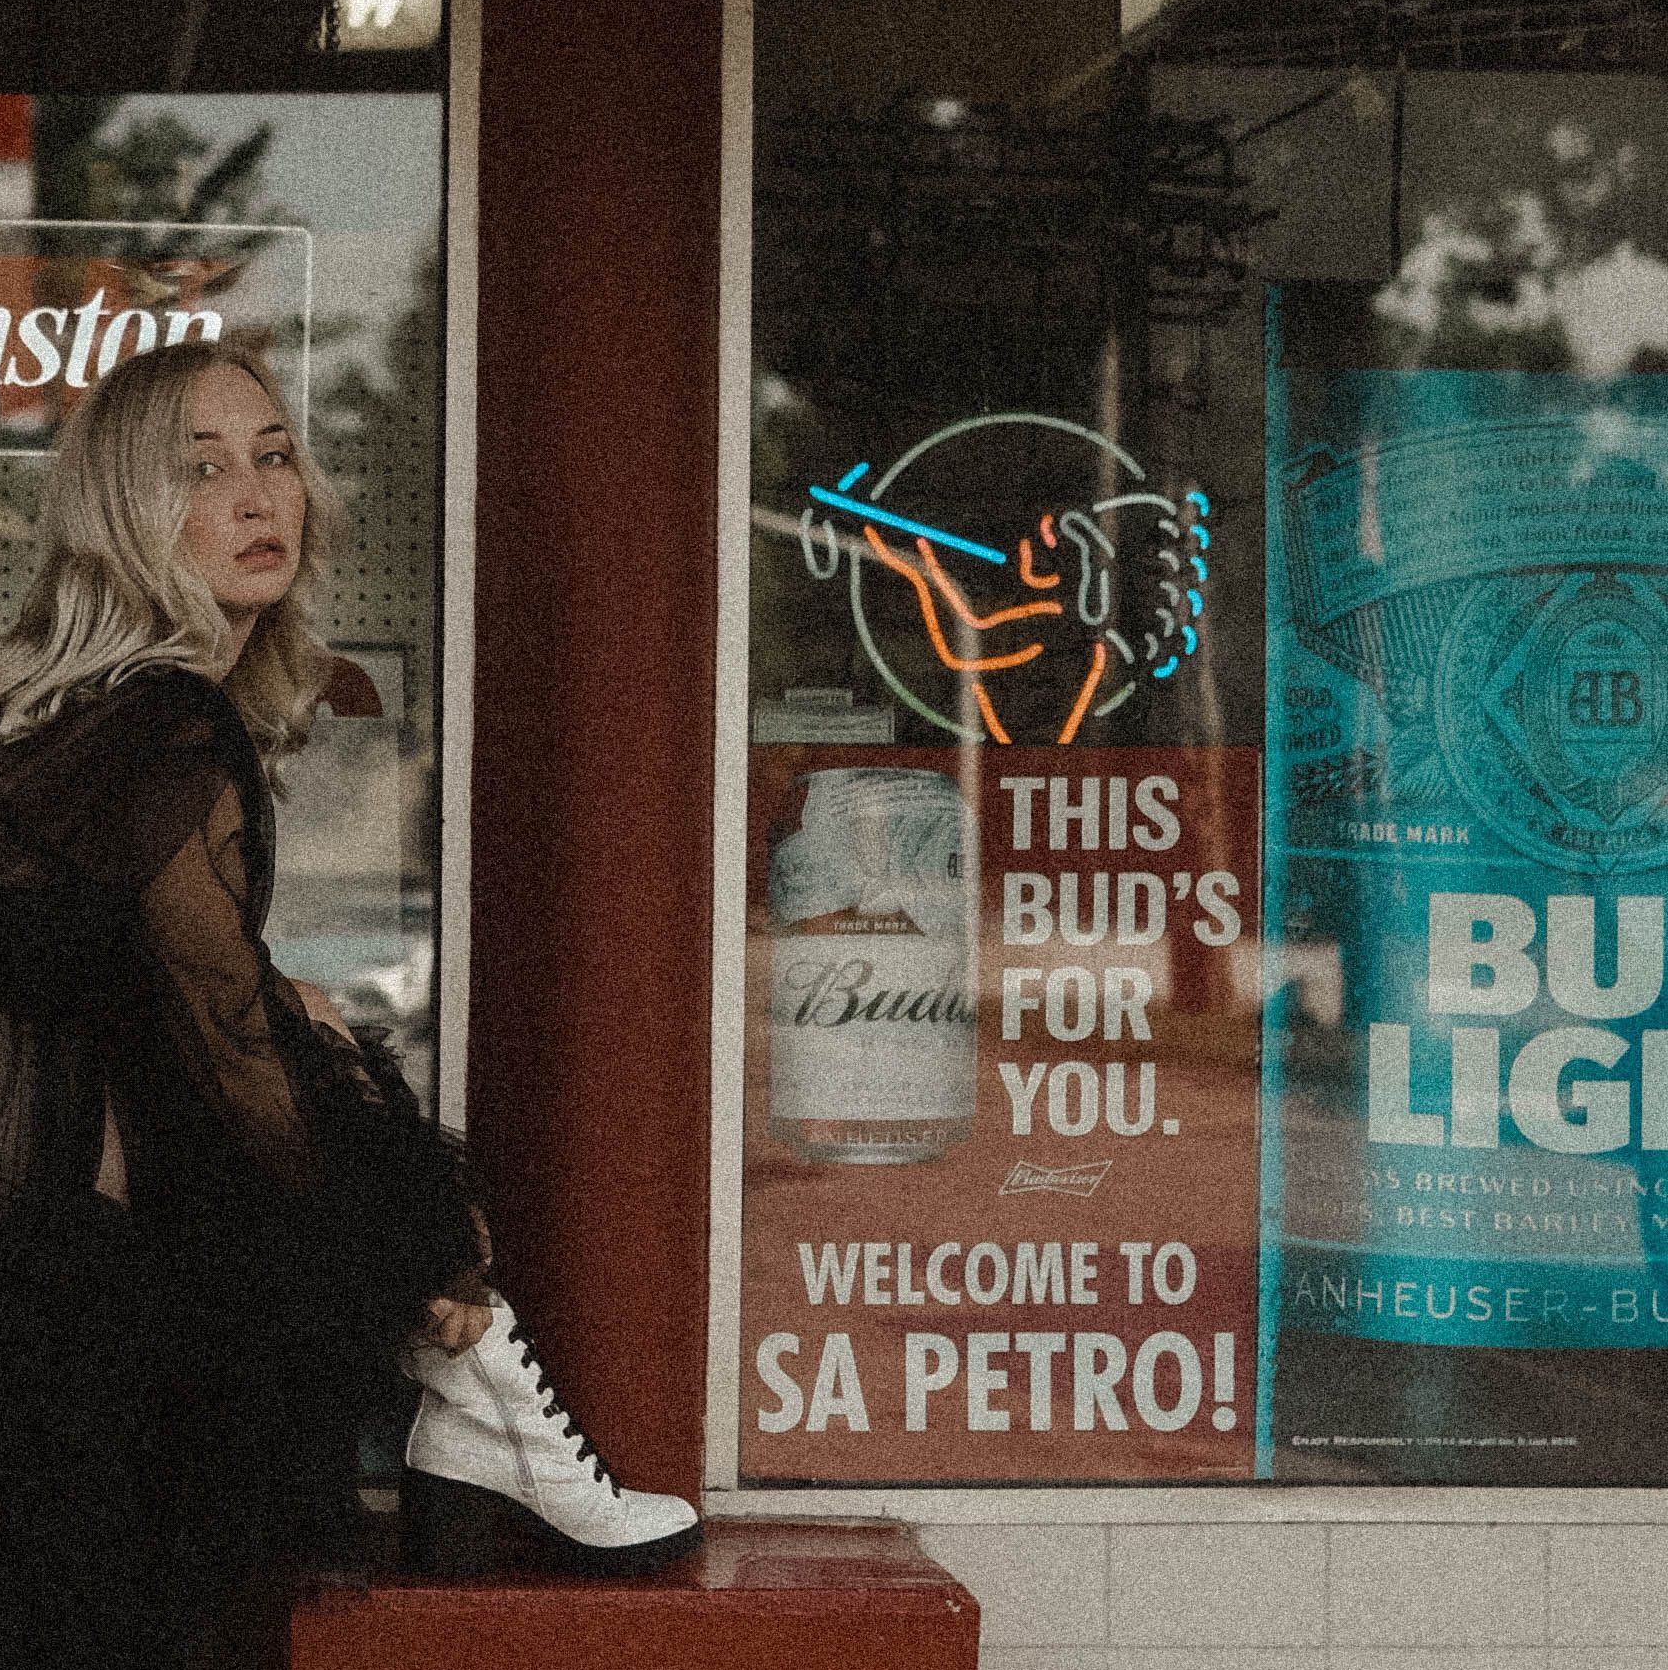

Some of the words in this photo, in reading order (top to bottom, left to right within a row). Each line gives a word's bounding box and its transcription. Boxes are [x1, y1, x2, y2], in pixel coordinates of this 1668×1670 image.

[998, 775, 1181, 852] THIS
[1405, 825, 1470, 846] MARK
[998, 871, 1242, 948] BUD'S
[1428, 891, 1666, 1020] BU
[999, 966, 1154, 1043] FOR
[997, 1061, 1181, 1138] YOU.
[1396, 1205, 1475, 1230] BEST
[1414, 1169, 1553, 1198] BREWED
[797, 1241, 1098, 1307] WELCOME
[1120, 1241, 1198, 1307] TO
[756, 1331, 871, 1434] SA
[904, 1331, 1238, 1435] PETRO!
